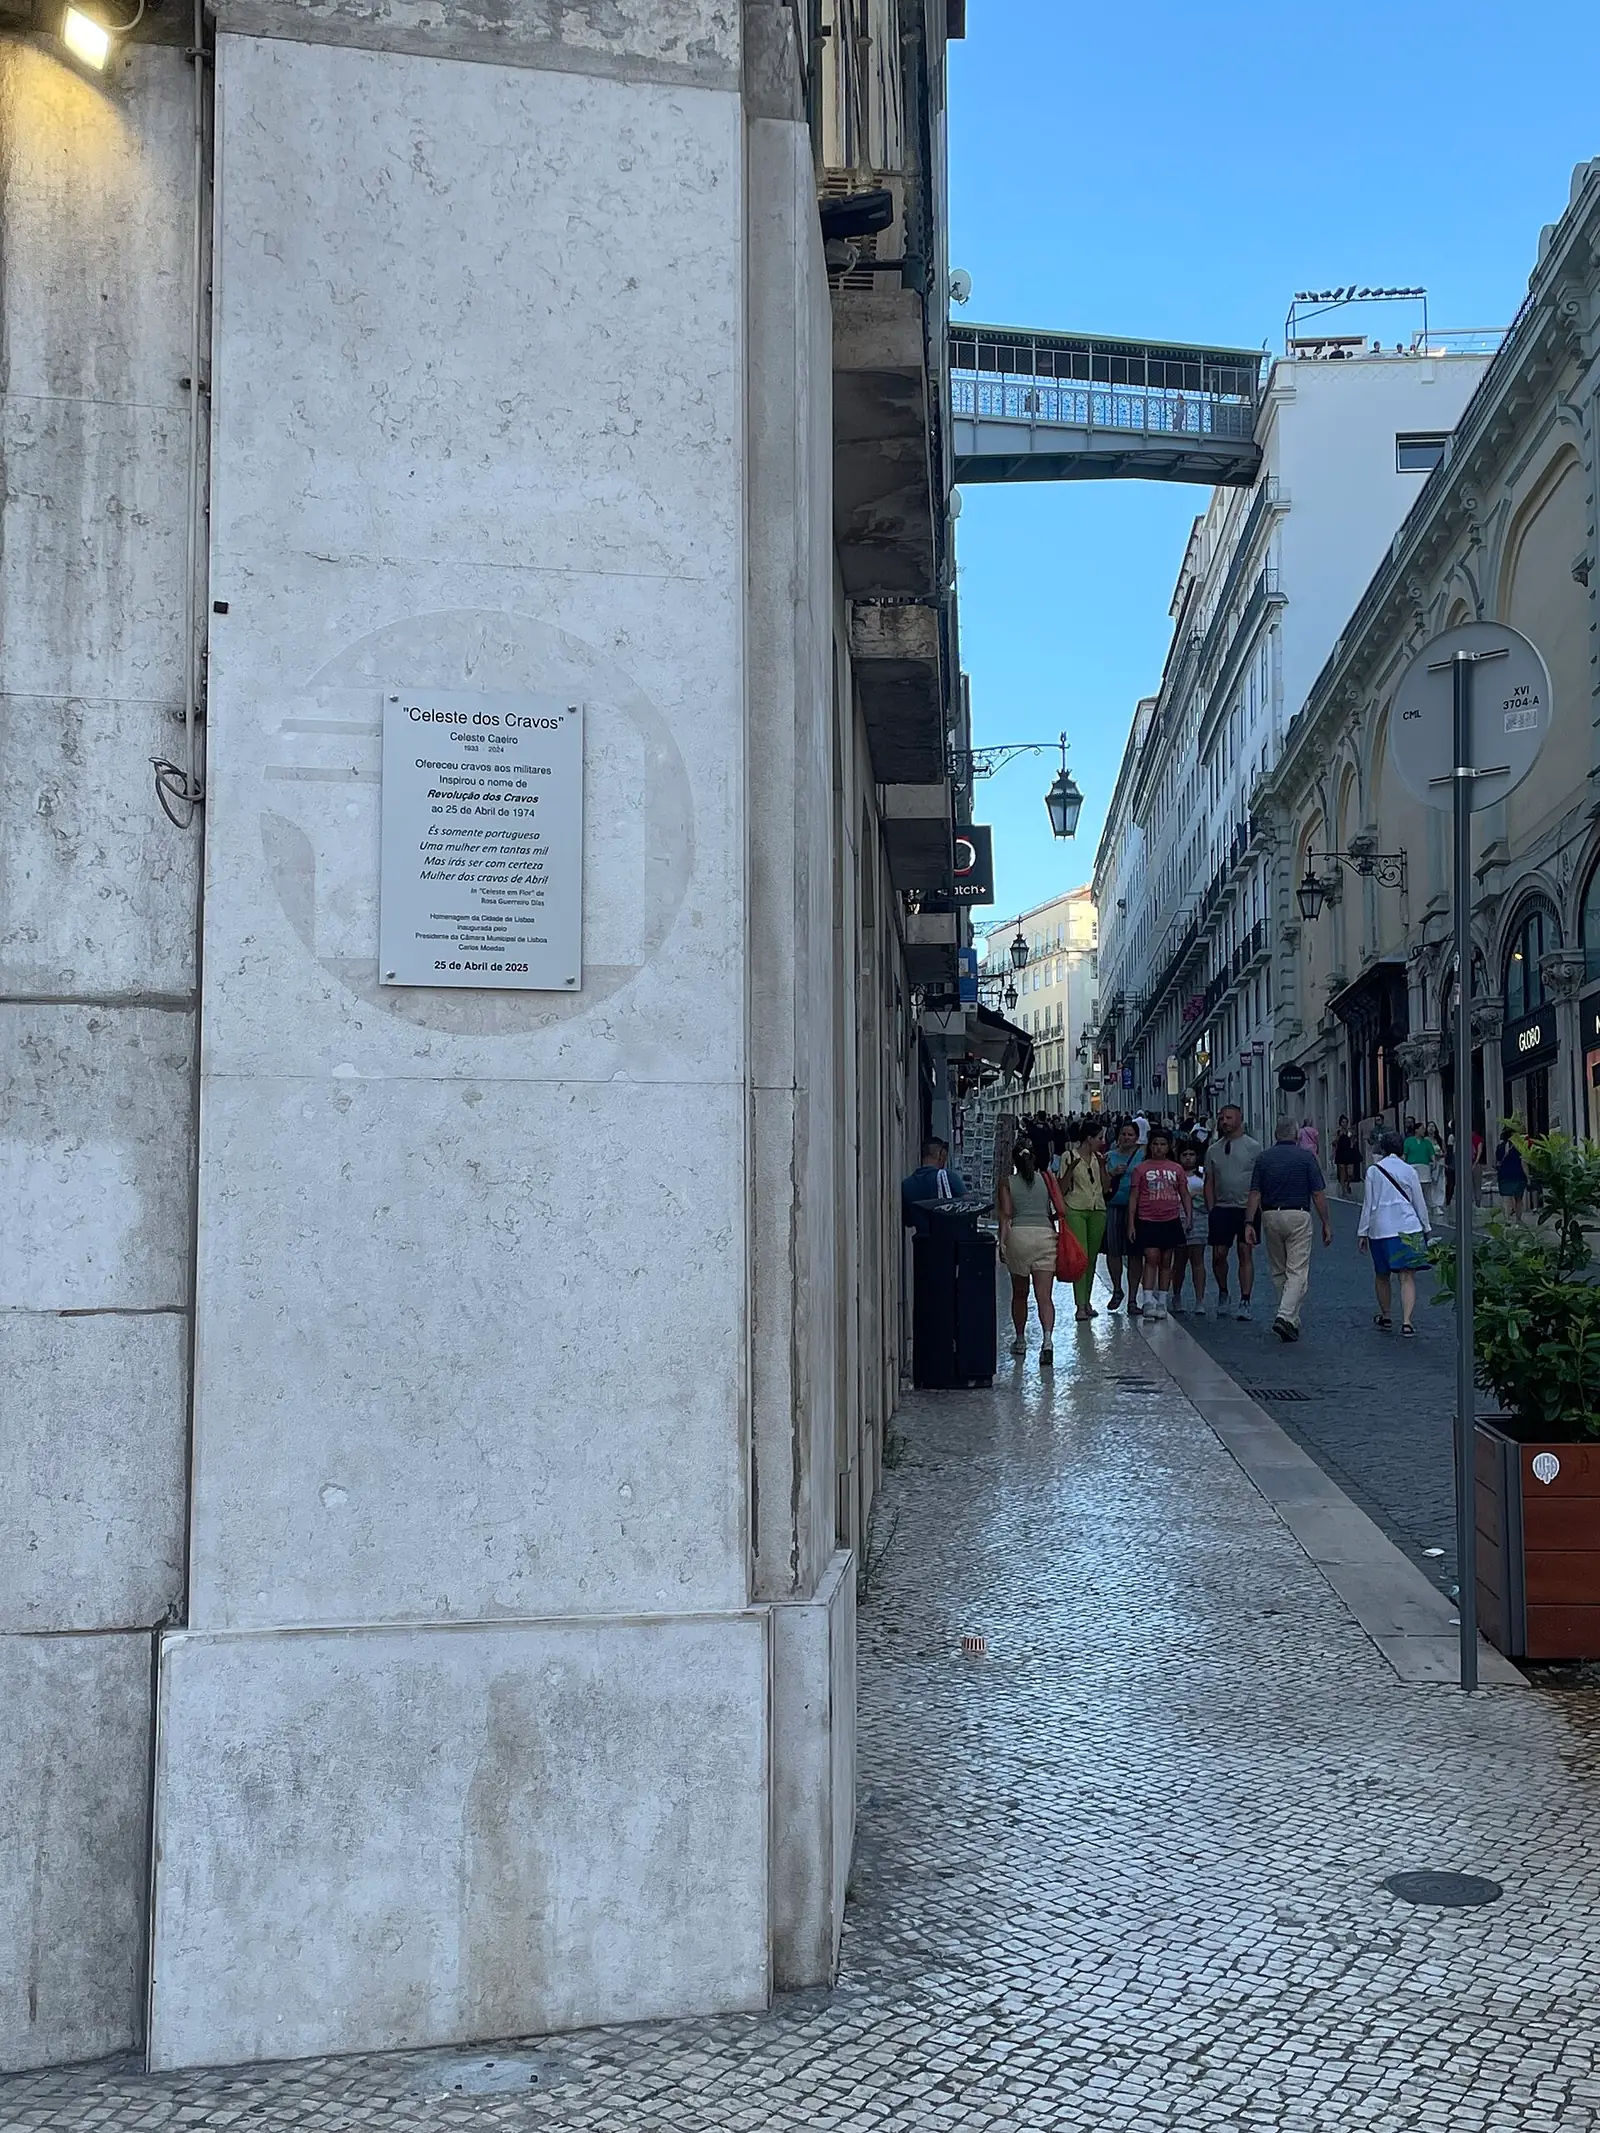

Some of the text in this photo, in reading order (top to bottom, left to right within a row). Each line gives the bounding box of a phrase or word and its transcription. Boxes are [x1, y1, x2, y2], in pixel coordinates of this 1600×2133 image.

[1514, 685, 1530, 696] XVI
[1503, 696, 1540, 710] 3704-A
[403, 707, 564, 730] "Celeste dos Cravos"
[1402, 710, 1422, 720] CML
[450, 732, 518, 744] Celeste Caeiro
[415, 758, 458, 770] Ofereceu
[461, 763, 492, 772] cravos
[514, 764, 552, 775] militares
[440, 775, 476, 786] Inspirou
[488, 780, 514, 788] nome
[516, 780, 528, 788] de
[427, 790, 539, 803] Revolução dos Cravos
[446, 804, 458, 814] 25
[460, 806, 472, 814] de
[474, 806, 496, 816] Abril
[498, 808, 510, 816] de
[513, 808, 535, 818] 1974
[428, 824, 540, 840] És somente portuguesa
[420, 841, 444, 850] Uma
[444, 842, 481, 852] mulher
[500, 846, 531, 854] tantas
[532, 846, 550, 856] mil
[424, 856, 544, 870] Mas irás ser com certeza
[420, 870, 550, 884] Mulher dos cravos de Abril
[430, 913, 470, 922] Homenagem
[434, 960, 529, 972] 25 de Abril de 2025
[1518, 1025, 1541, 1052] GLOBO
